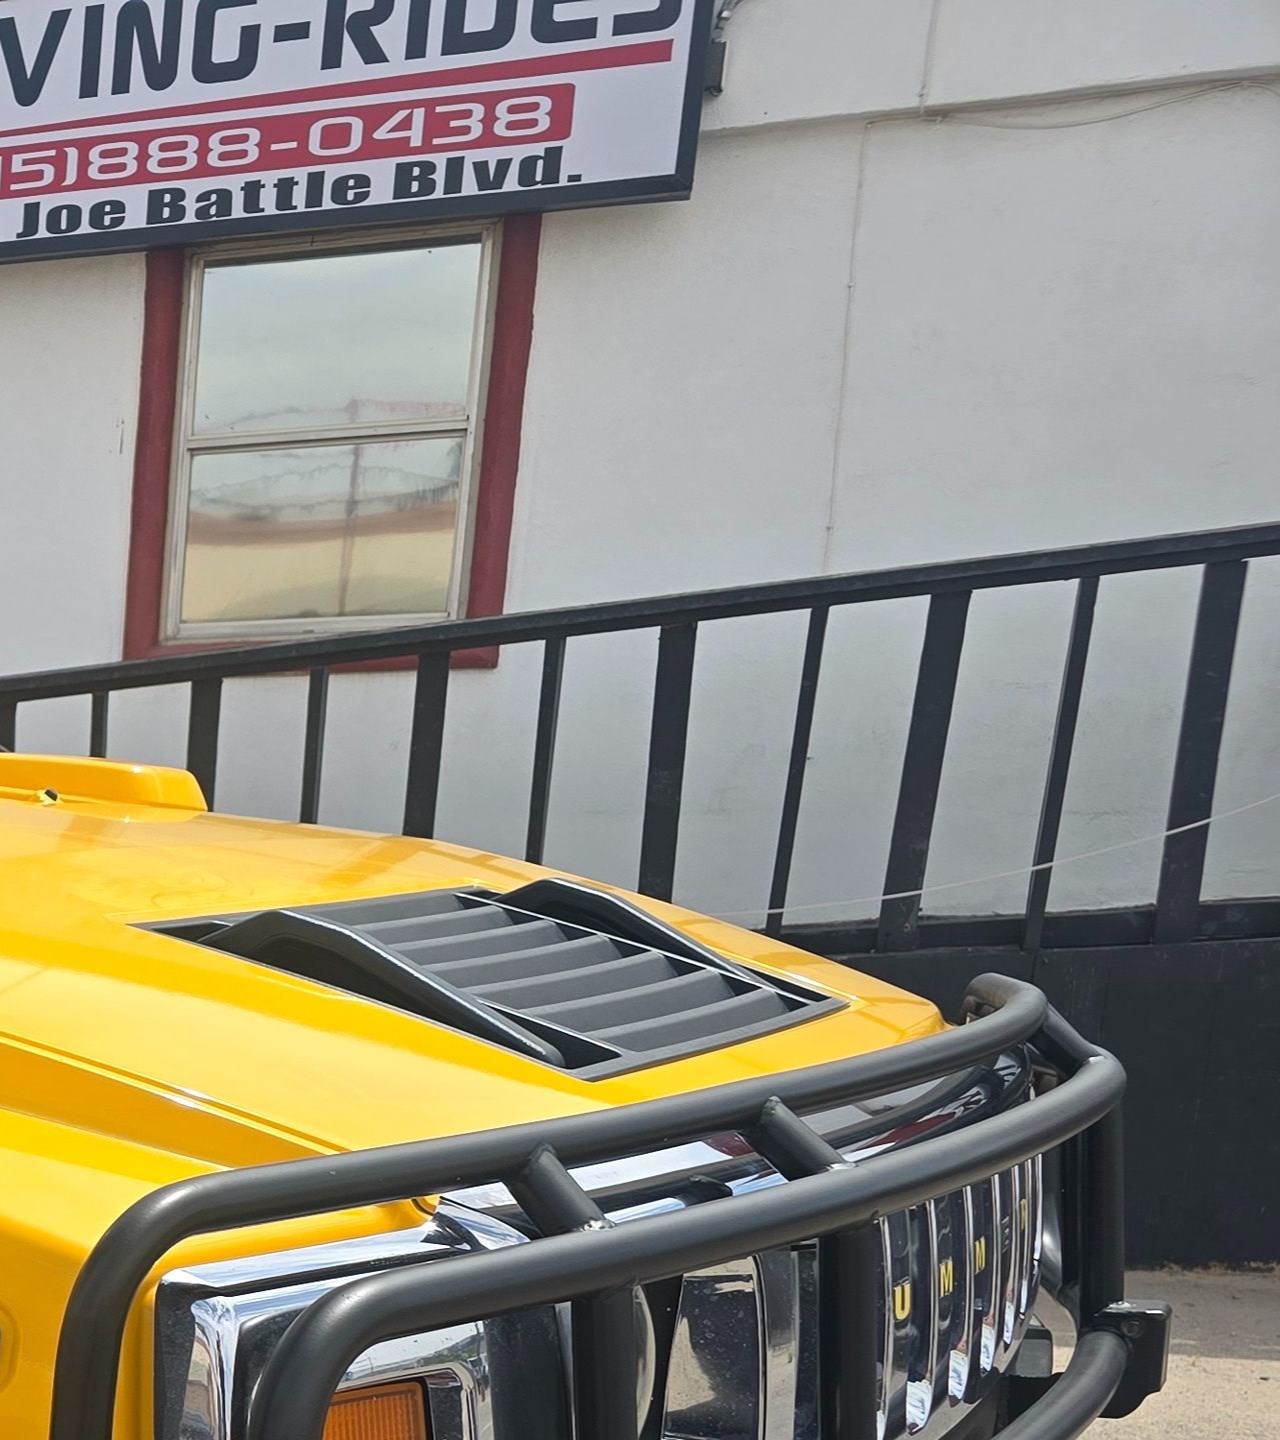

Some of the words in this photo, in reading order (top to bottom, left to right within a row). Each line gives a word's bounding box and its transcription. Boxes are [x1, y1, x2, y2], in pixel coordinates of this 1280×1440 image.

[15, 199, 127, 240] Joe
[145, 171, 372, 226] Battle
[392, 145, 582, 201] Blvd.
